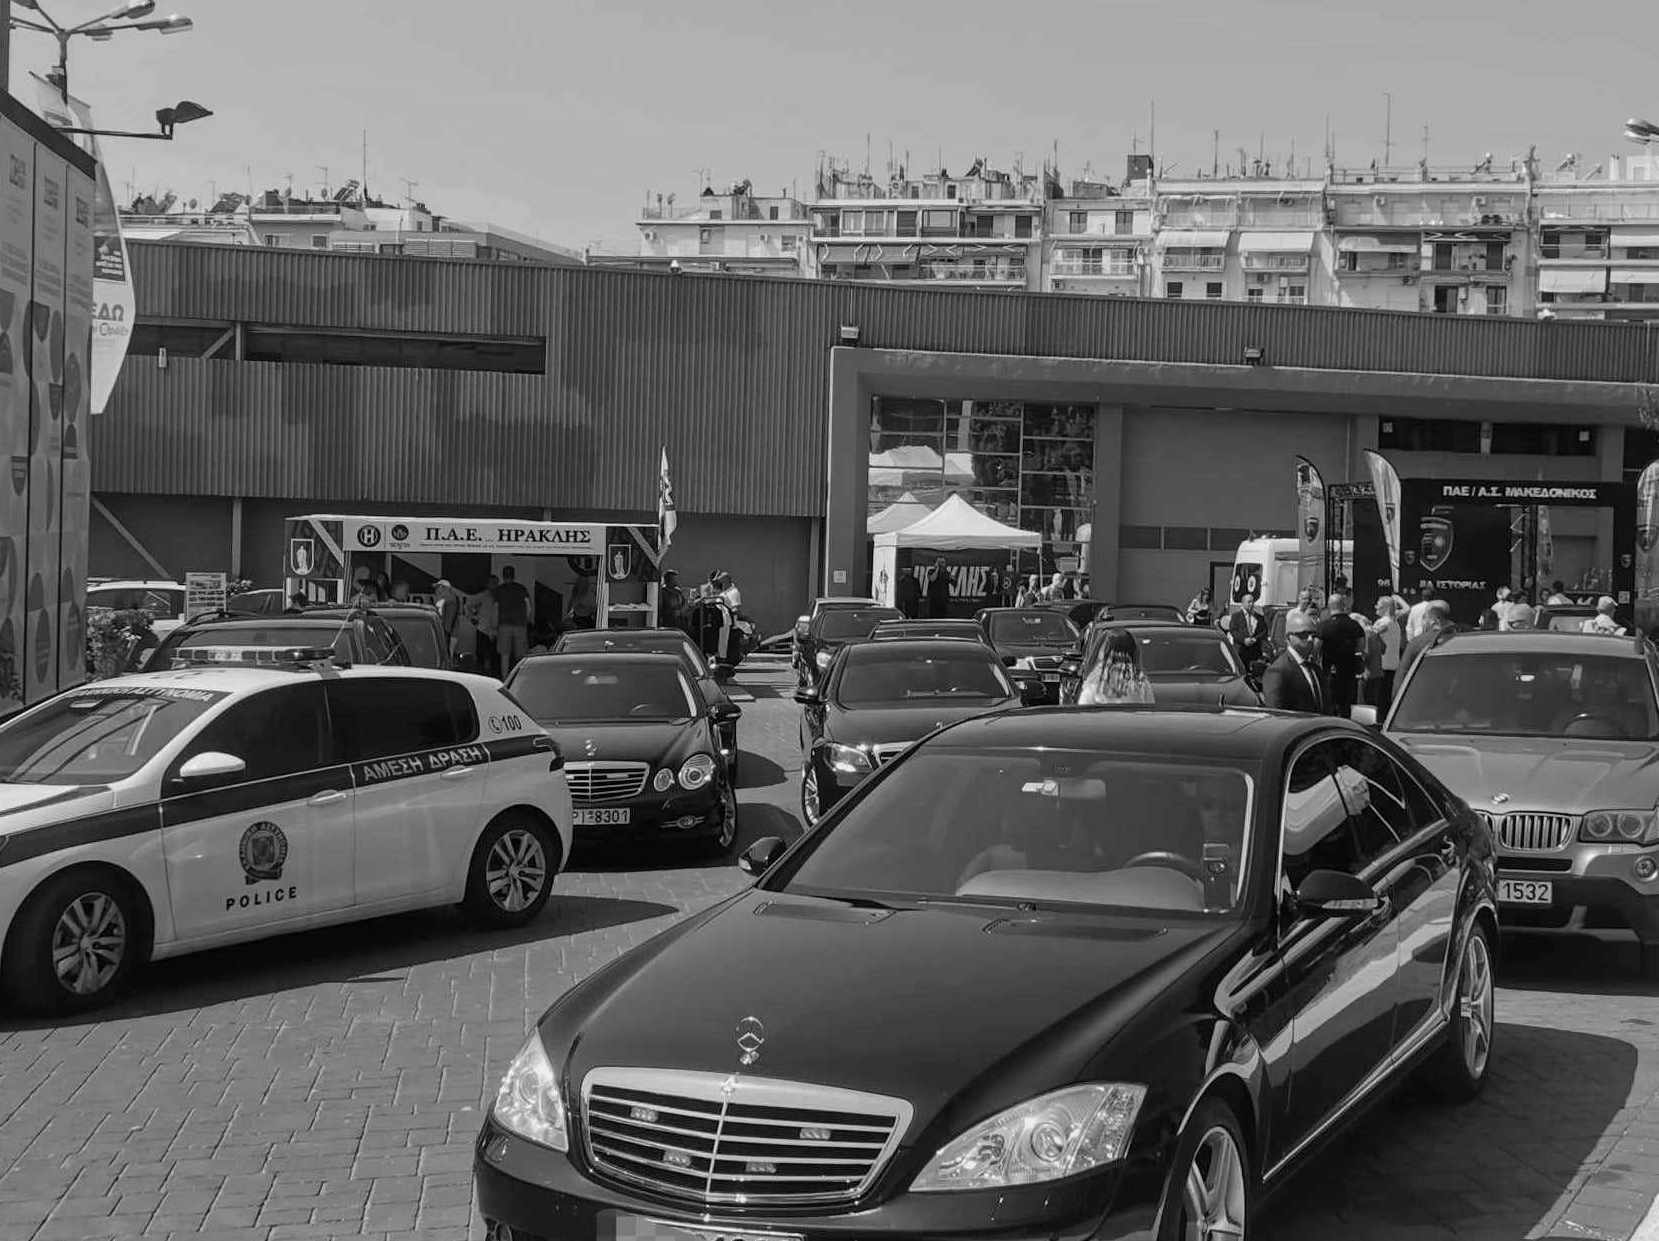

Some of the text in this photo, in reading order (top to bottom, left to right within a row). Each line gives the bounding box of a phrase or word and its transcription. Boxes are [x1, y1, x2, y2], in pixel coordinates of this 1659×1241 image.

[1443, 486, 1470, 496] ΠΑΕ
[1505, 487, 1597, 499] ΜΑΚΕΔΟΝΙΚΟΣ
[425, 527, 482, 542] Π.Α.Ε.
[498, 528, 591, 543] ΗΡΑΚΛΗΣ
[501, 715, 522, 731] 100
[363, 746, 483, 782] ΑΜΕΣΗ ΔΡΑΣΗ
[226, 886, 297, 911] POLICE
[1503, 882, 1549, 901] 1532
